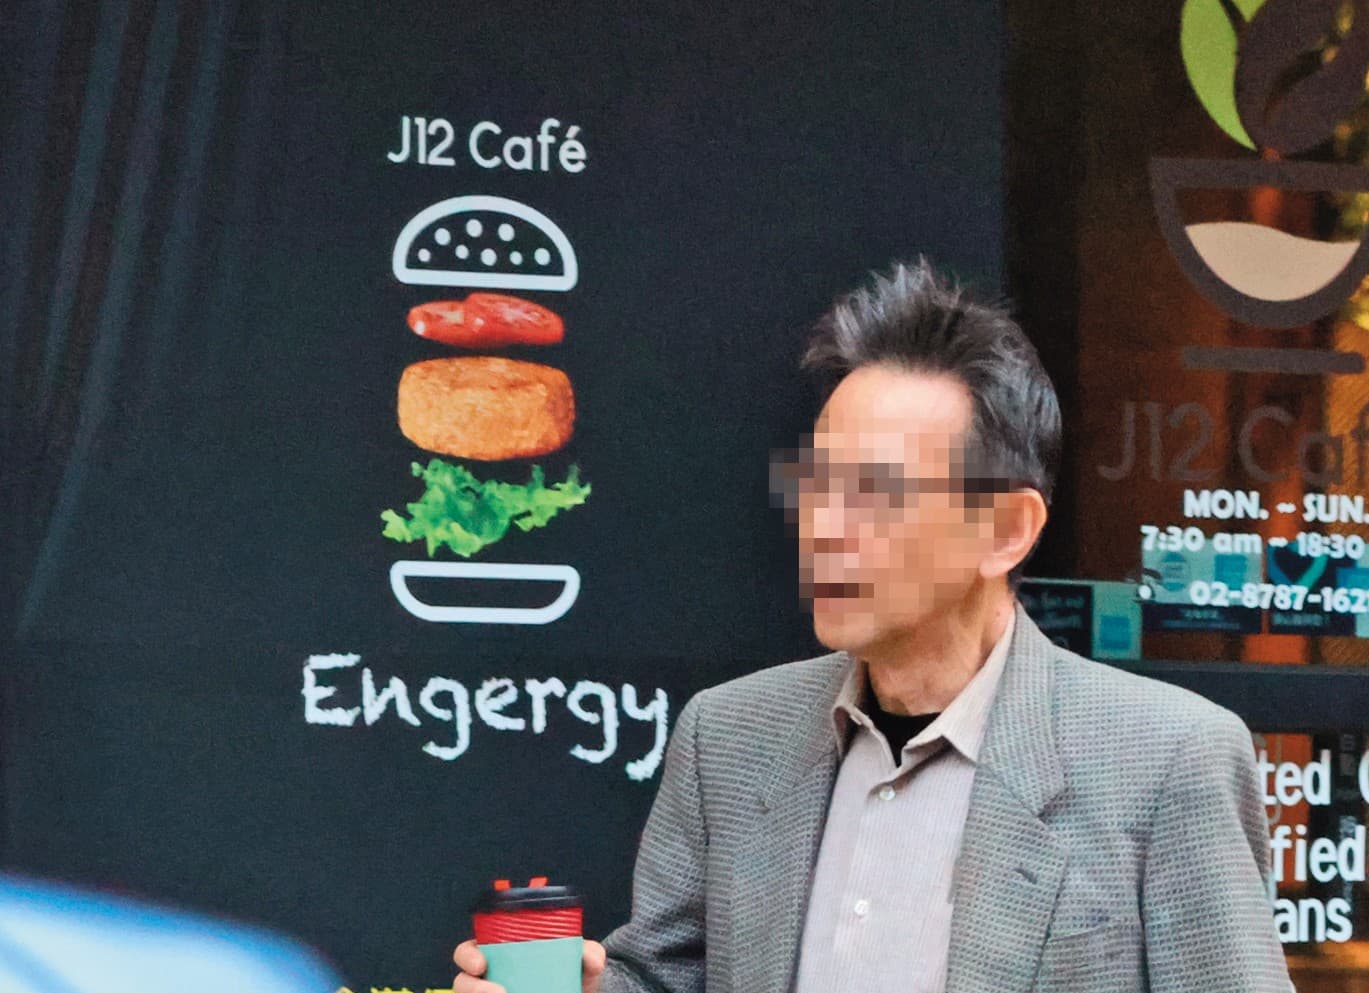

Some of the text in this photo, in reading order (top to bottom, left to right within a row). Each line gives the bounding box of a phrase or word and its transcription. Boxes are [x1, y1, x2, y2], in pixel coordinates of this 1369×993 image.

[387, 116, 588, 174] J12 Café
[1097, 400, 1219, 483] J12
[1183, 489, 1269, 520] MON.
[1140, 524, 1206, 552] 7:30
[1212, 532, 1263, 554] am
[1296, 531, 1364, 560] 18:30
[301, 652, 670, 782] Engergy
[1256, 748, 1332, 806] ted
[1269, 823, 1367, 883] fied
[1271, 897, 1354, 943] ans
